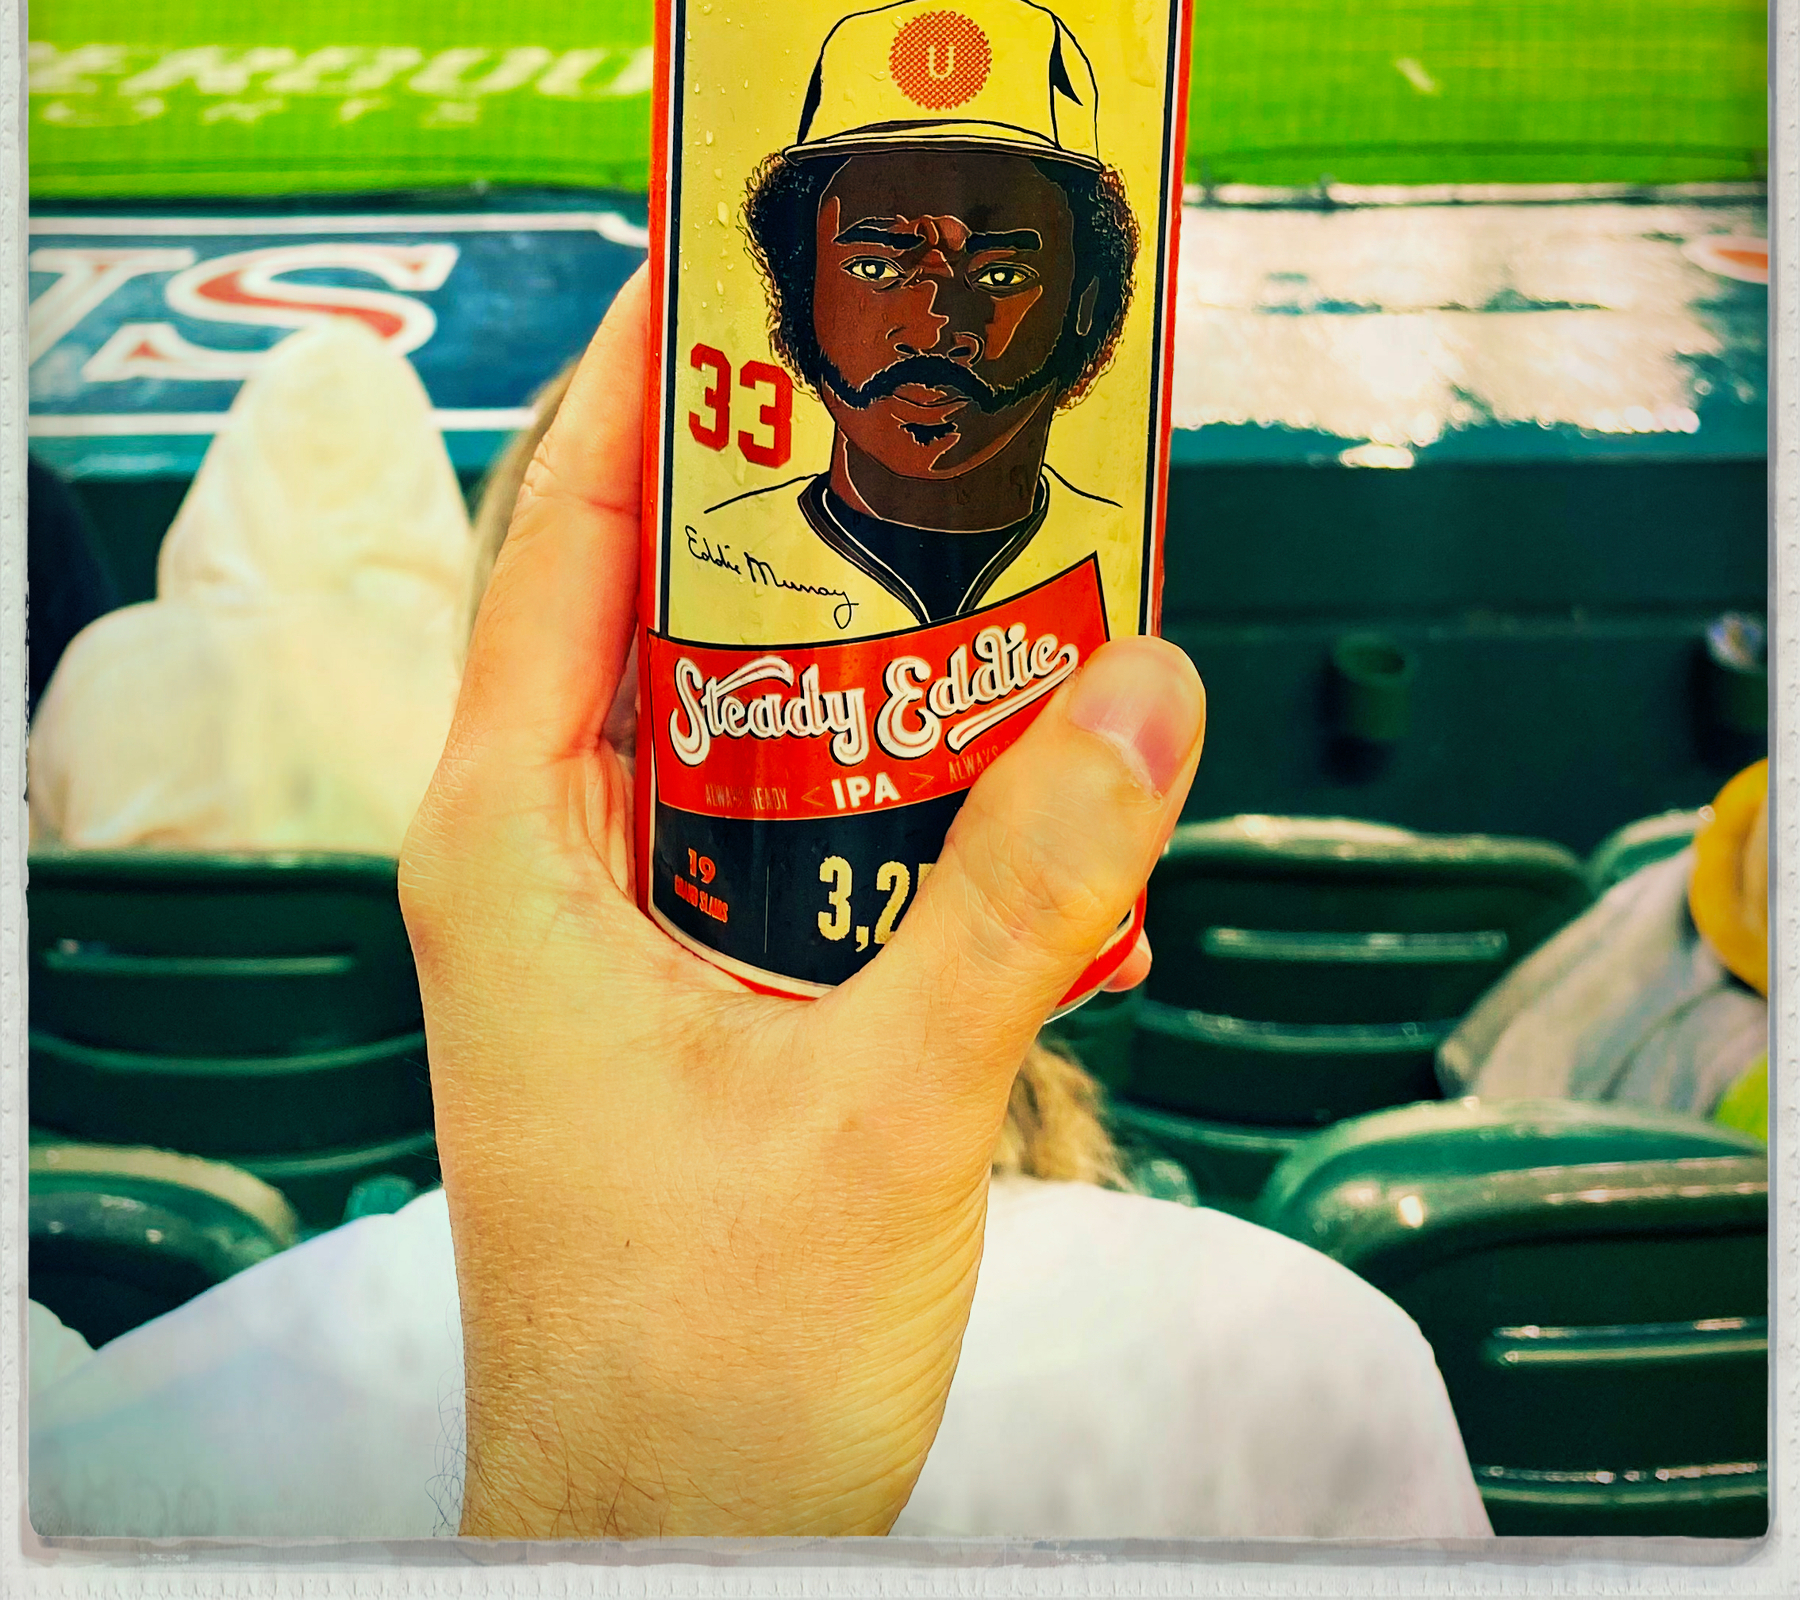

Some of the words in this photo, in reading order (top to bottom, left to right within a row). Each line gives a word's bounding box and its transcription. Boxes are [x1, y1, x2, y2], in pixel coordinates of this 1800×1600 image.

[927, 45, 956, 80] U
[688, 342, 793, 469] 33
[685, 524, 741, 574] Eddie
[669, 654, 869, 766] Steady
[874, 621, 1079, 760] Eddie
[831, 771, 901, 811] IPA
[688, 847, 716, 884] 19
[818, 855, 936, 952] 3,2
